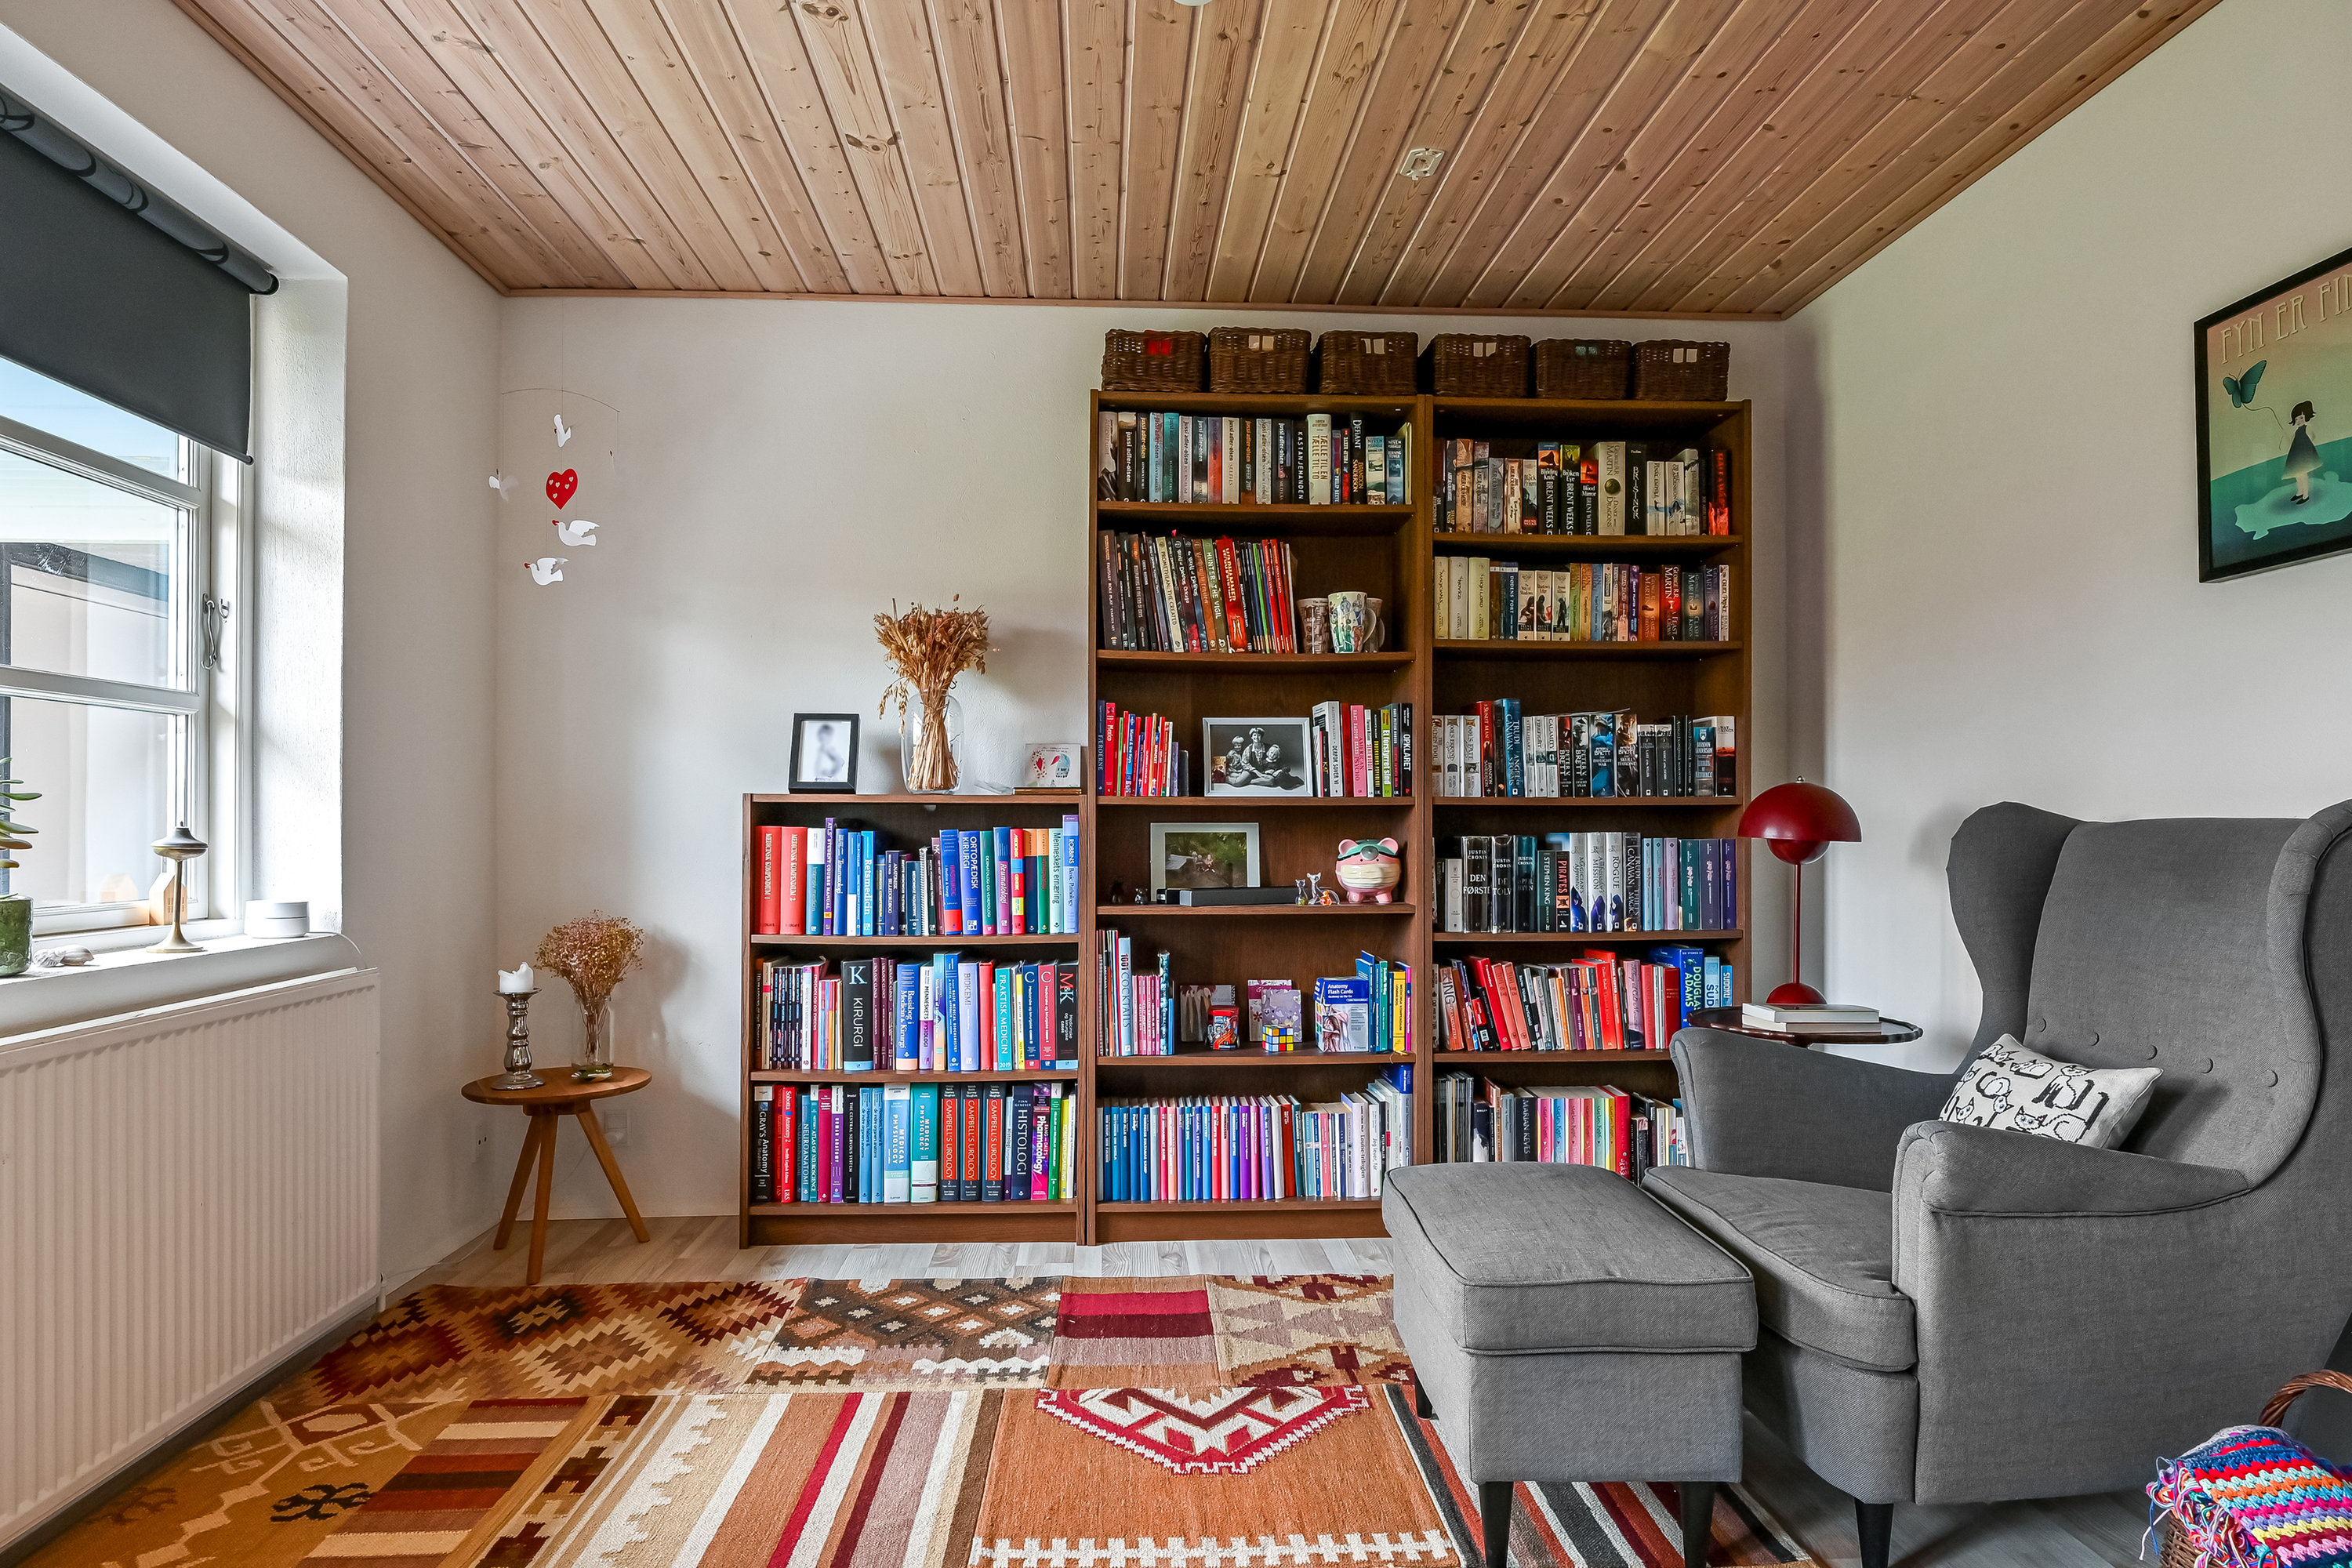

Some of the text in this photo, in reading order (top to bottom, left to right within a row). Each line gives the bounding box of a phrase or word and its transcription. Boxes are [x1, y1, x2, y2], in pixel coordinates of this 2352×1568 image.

[2220, 312, 2265, 365] FYN
[2275, 294, 2308, 342] ER
[1353, 419, 1362, 449] DEFIANT
[1312, 471, 1319, 480] TO
[1320, 471, 1328, 480] EN
[1161, 551, 1171, 587] PROMETHEAN:
[1206, 552, 1215, 583] HUNTER:
[1222, 547, 1236, 602] WARHAMMER
[1664, 567, 1673, 599] MARTIN
[1505, 714, 1514, 750] CANAVAN
[1382, 737, 1391, 769] forstyrret
[836, 858, 844, 895] Traumatologi
[970, 837, 978, 889] ORTOPÆDISK
[1558, 861, 1568, 893] PIRATES
[1625, 848, 1635, 884] CANAVAN
[864, 859, 873, 916] Retsmedicin
[999, 863, 1008, 904] Reumatologi
[1052, 874, 1061, 904] ernæring
[906, 990, 915, 1020] Basisbog
[1059, 972, 1074, 1004] M&K
[1120, 953, 1131, 1028] 1001 COCKTAILS
[1685, 972, 1694, 1007] ADAMS
[853, 997, 863, 1047] KIRURGI
[898, 1024, 907, 1048] Kirurgi
[760, 1139, 769, 1173] Anatomy
[1017, 1109, 1028, 1175] HISTOLOGI
[1033, 1116, 1046, 1174] Pharmacology
